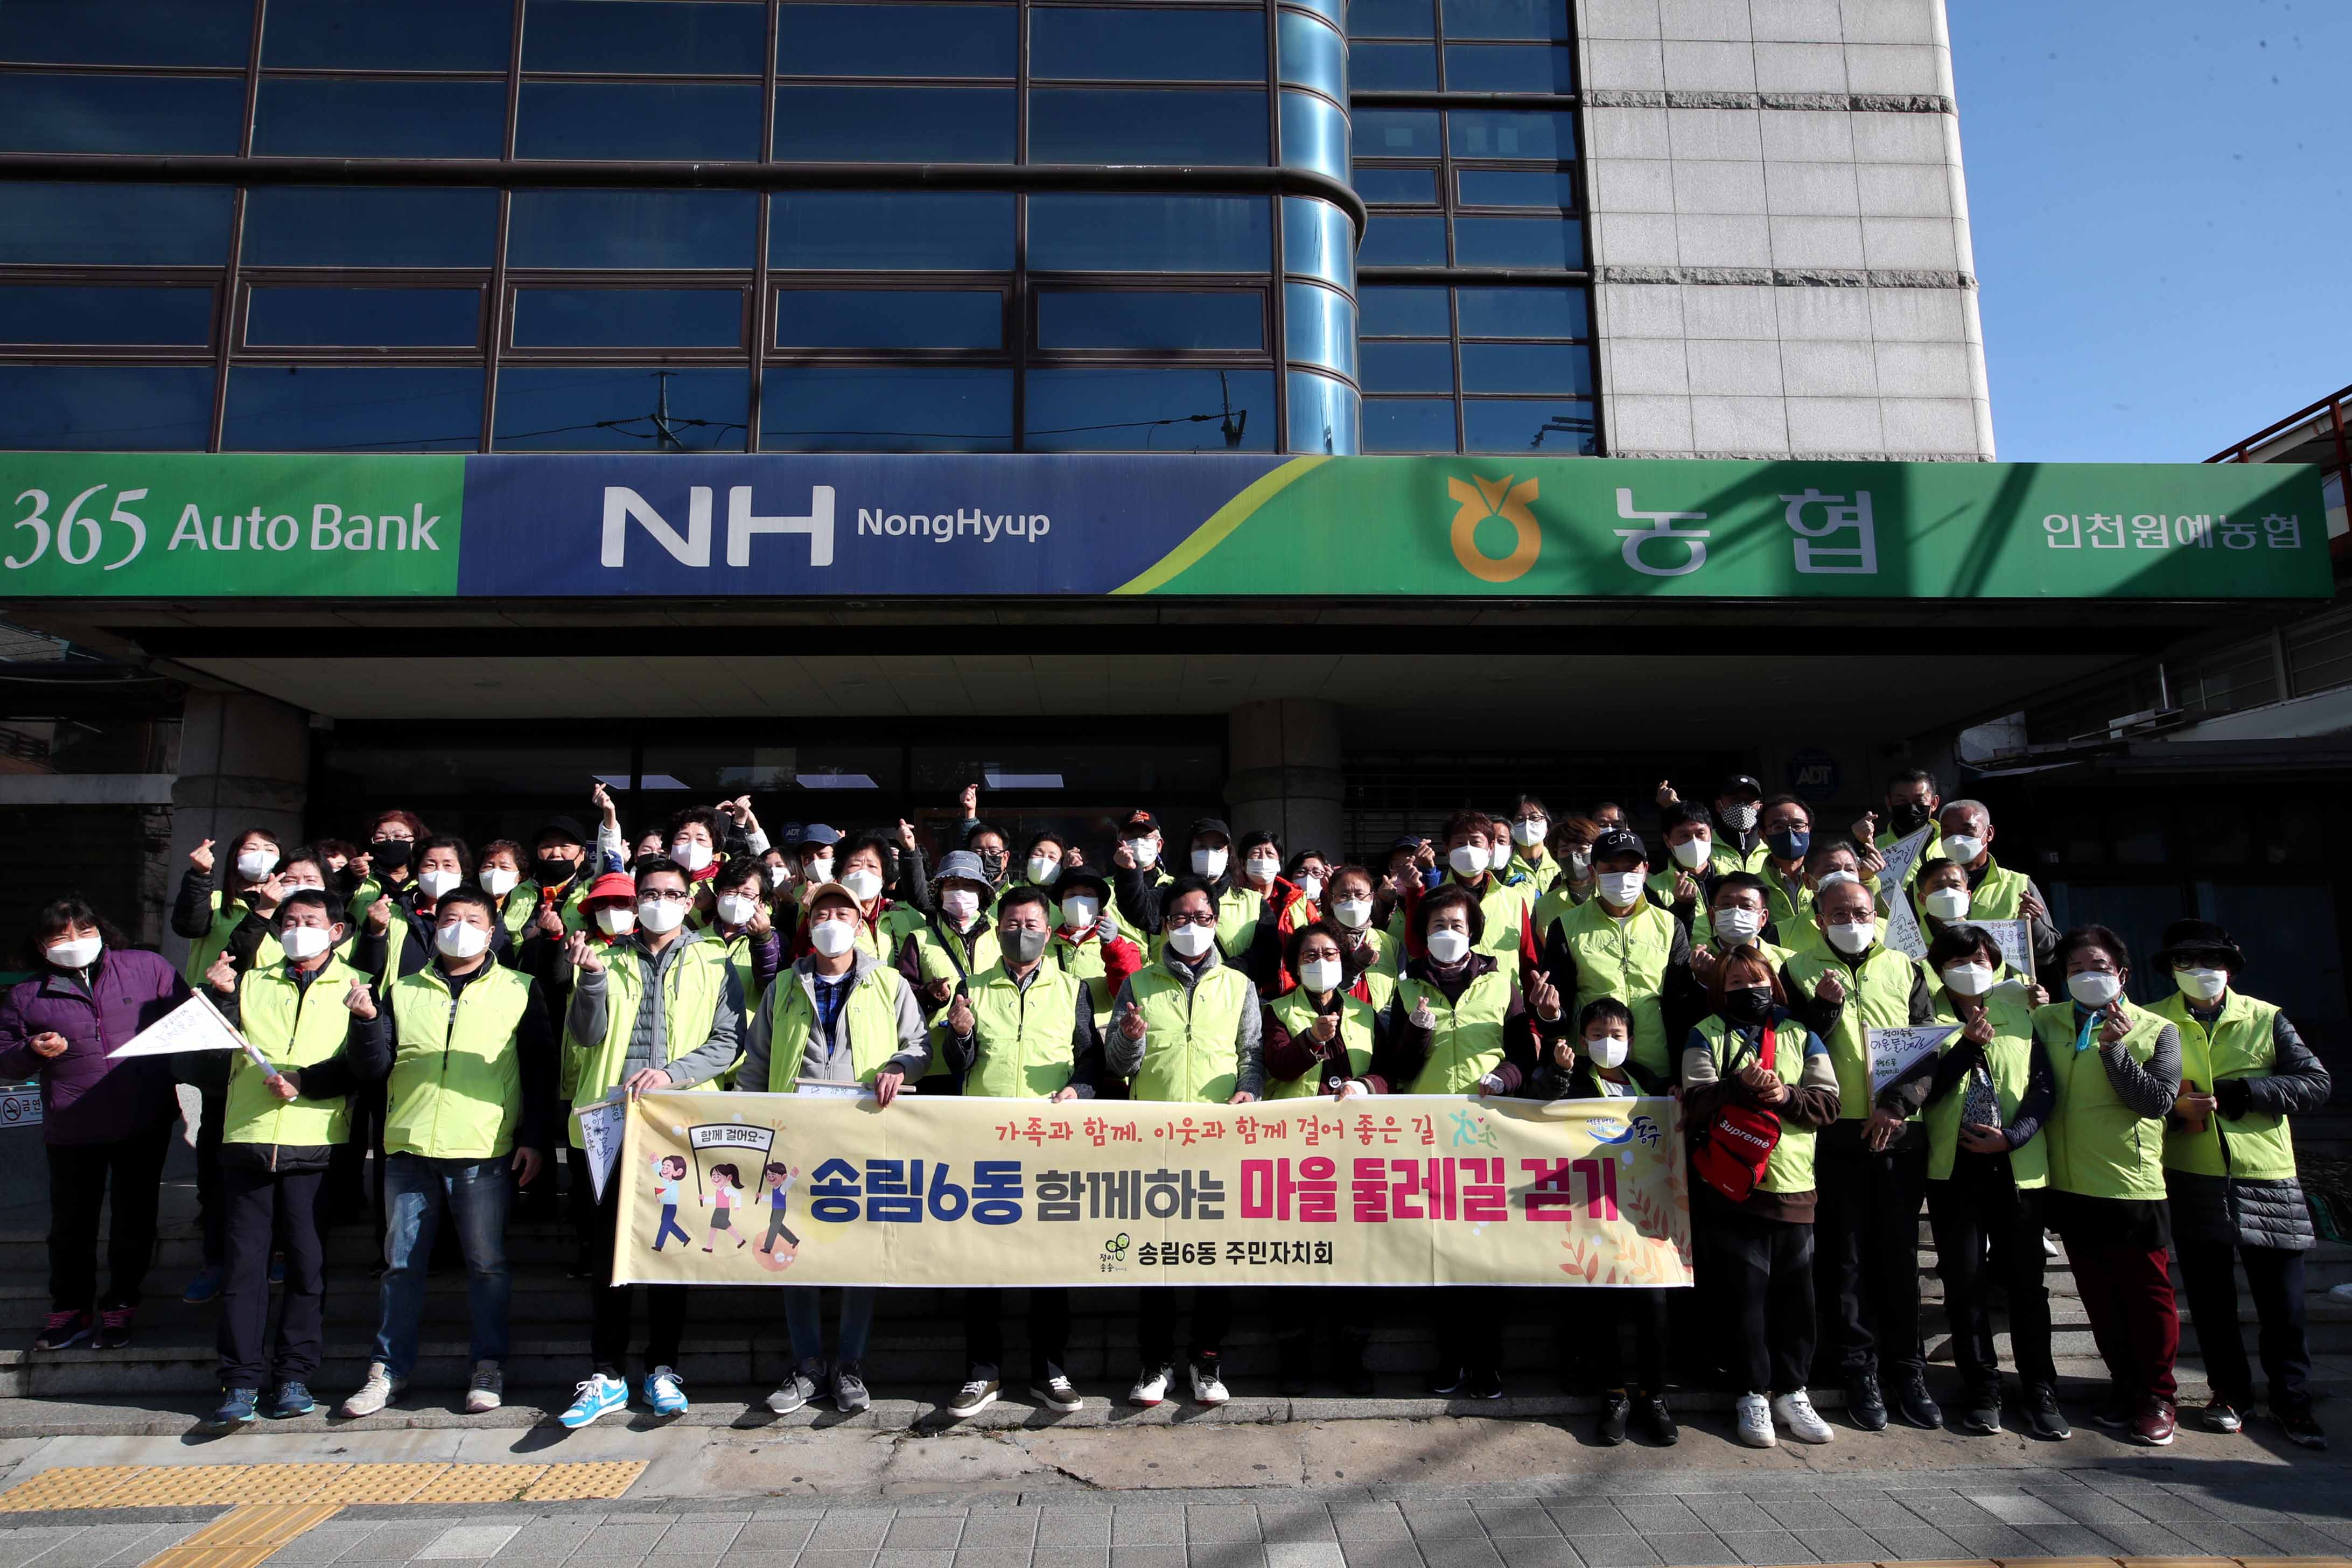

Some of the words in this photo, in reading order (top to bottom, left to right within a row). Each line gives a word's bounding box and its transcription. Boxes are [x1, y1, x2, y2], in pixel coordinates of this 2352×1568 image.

[4, 483, 149, 571] 365
[167, 503, 299, 552] Auto
[310, 502, 441, 552] Bank
[600, 485, 836, 568] NH
[858, 508, 1051, 543] NongHyup
[1612, 487, 1879, 577] 농협
[2042, 513, 2302, 550] 인천원예농협
[1607, 832, 1635, 845] CPT
[22, 1098, 41, 1112] 금연
[701, 1129, 722, 1143] 함께
[726, 1129, 765, 1143] 걸어요~
[995, 1116, 1073, 1147] 가족과
[1083, 1116, 1143, 1147] 함께.
[1154, 1116, 1226, 1146] 이웃과
[1236, 1116, 1287, 1145] 함께
[1297, 1114, 1344, 1146] 걸어
[1354, 1114, 1402, 1145] 좋은
[1412, 1114, 1437, 1145] 길
[1633, 1116, 1662, 1149] 동구
[1719, 1119, 1770, 1149] Supreme
[809, 1158, 1024, 1225] 송림6동
[1035, 1168, 1225, 1221] 함께하는
[1241, 1156, 1338, 1223] 마을
[1352, 1157, 1508, 1222] 둘레길
[1521, 1157, 1618, 1222] 걷기
[1137, 1241, 1217, 1265] 송림6동
[1226, 1241, 1333, 1265] 주민자치회
